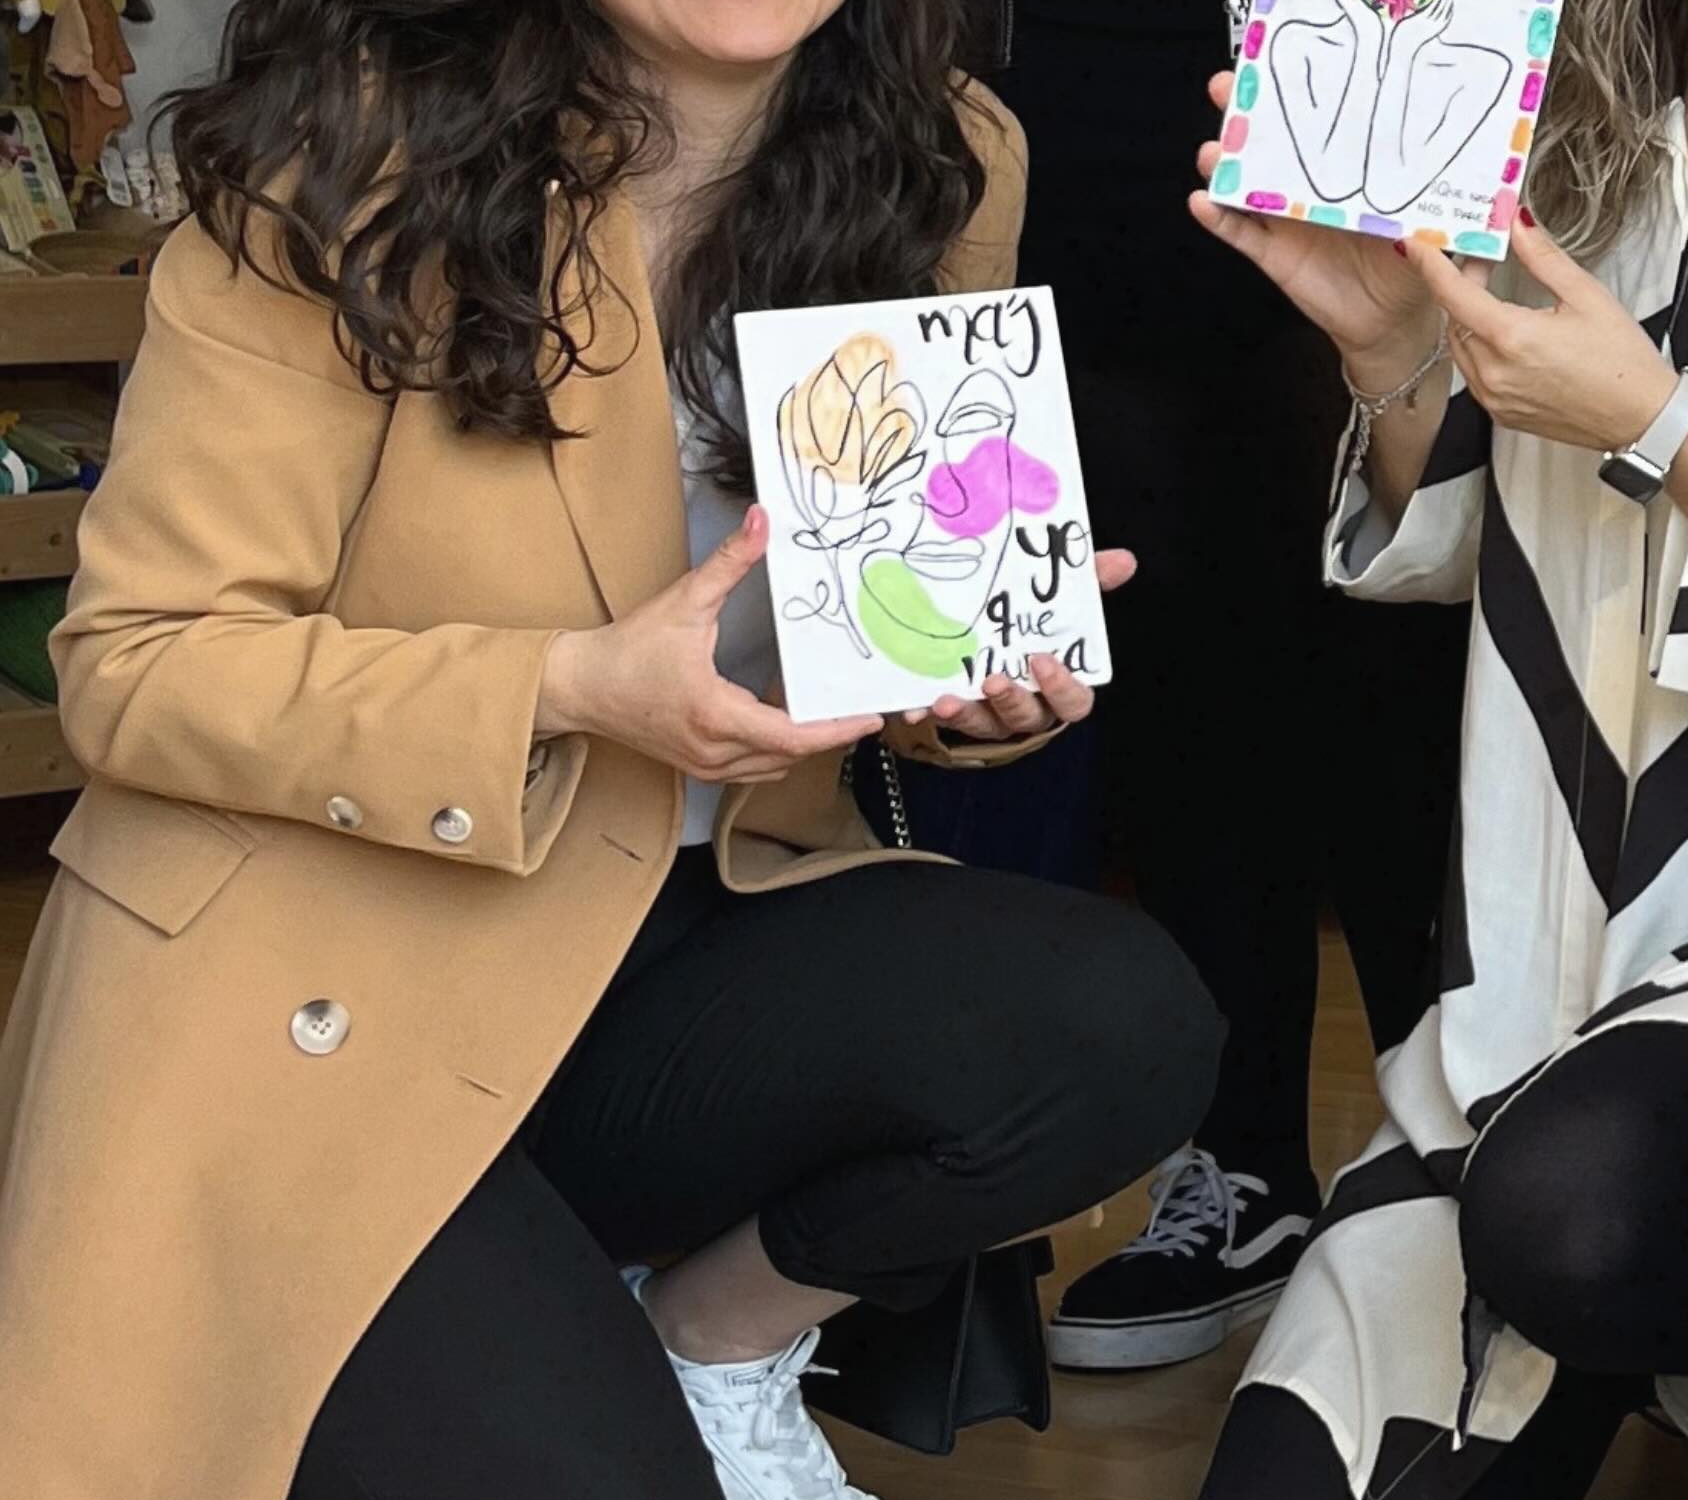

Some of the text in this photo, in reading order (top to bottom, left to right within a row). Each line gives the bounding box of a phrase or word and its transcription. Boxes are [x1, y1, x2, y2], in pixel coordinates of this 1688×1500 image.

[1015, 519, 1090, 603] yo
[986, 590, 1068, 647] que
[961, 636, 1100, 686] nua
